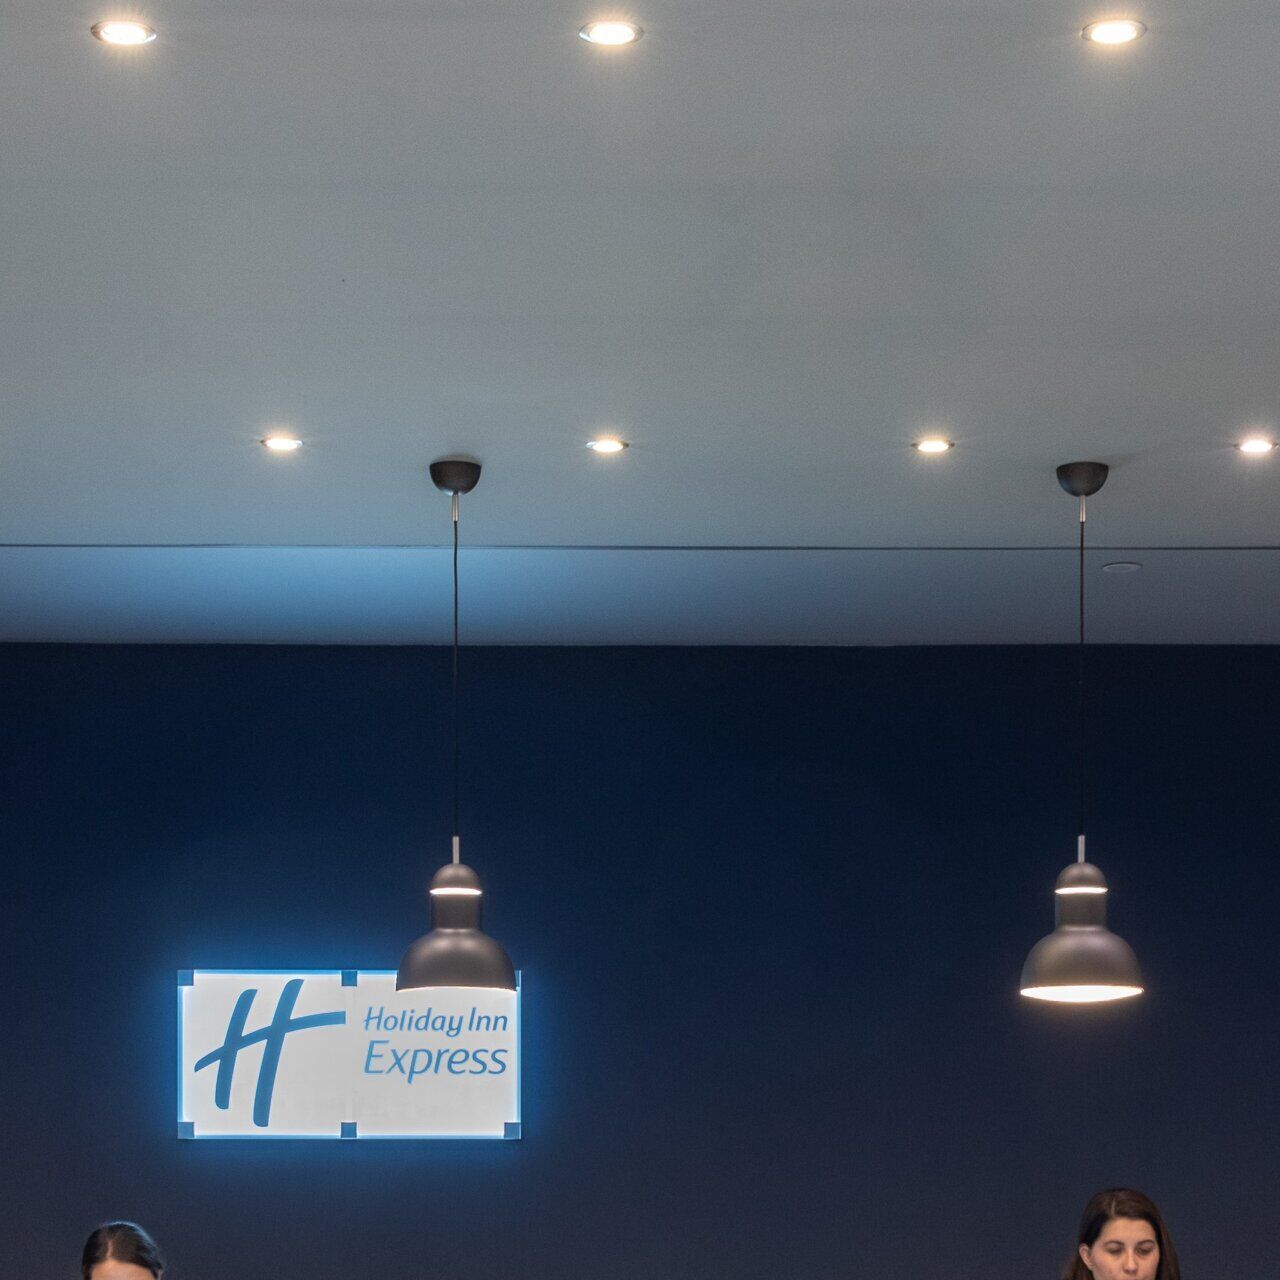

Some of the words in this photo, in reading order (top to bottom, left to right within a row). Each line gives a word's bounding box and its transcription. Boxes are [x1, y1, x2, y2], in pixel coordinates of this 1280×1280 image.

[363, 1005, 464, 1037] Holiday
[468, 1006, 508, 1032] Inn
[363, 1039, 508, 1085] Express
